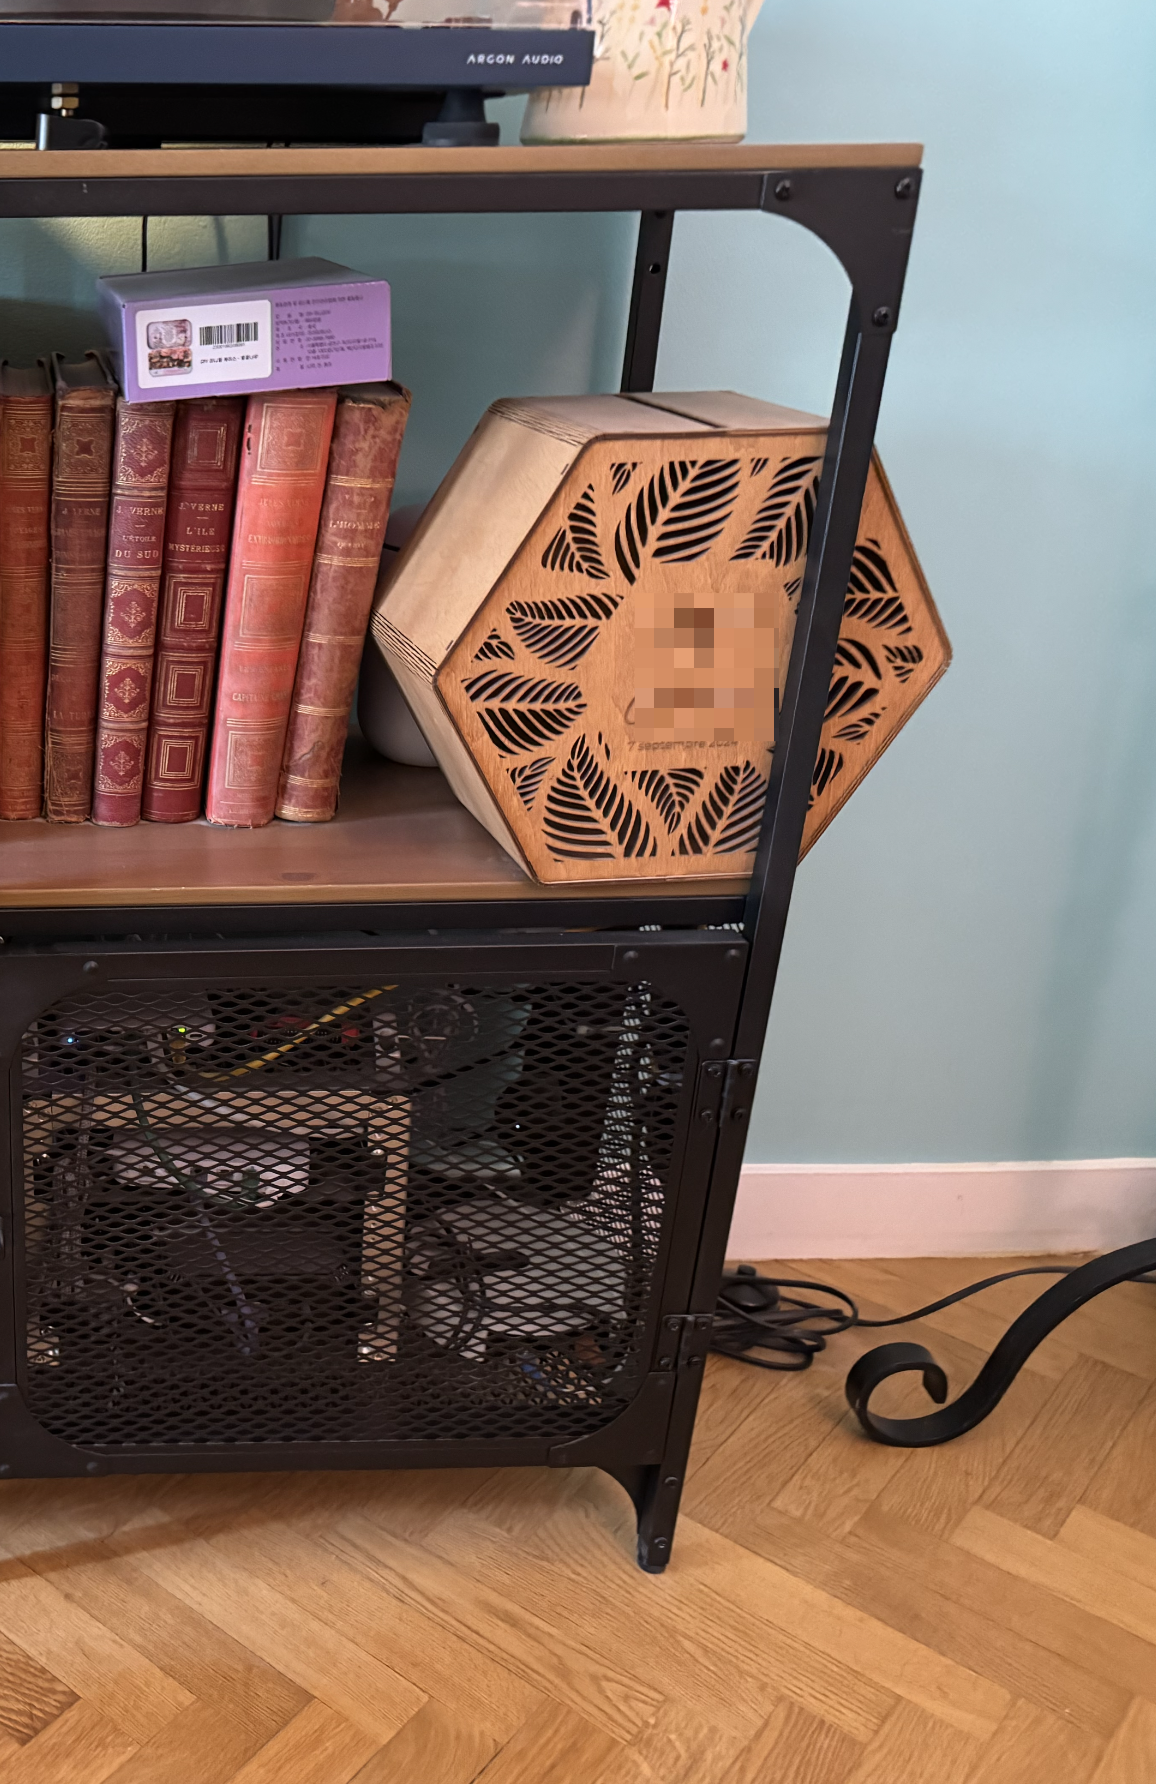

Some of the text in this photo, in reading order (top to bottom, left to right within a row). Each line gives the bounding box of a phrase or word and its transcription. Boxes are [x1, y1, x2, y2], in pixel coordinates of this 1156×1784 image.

[467, 53, 563, 65] ARGON AUDIO
[129, 506, 164, 516] VERNE
[190, 503, 225, 511] VERNE
[115, 549, 159, 559] DU SUD
[627, 741, 637, 751] 7
